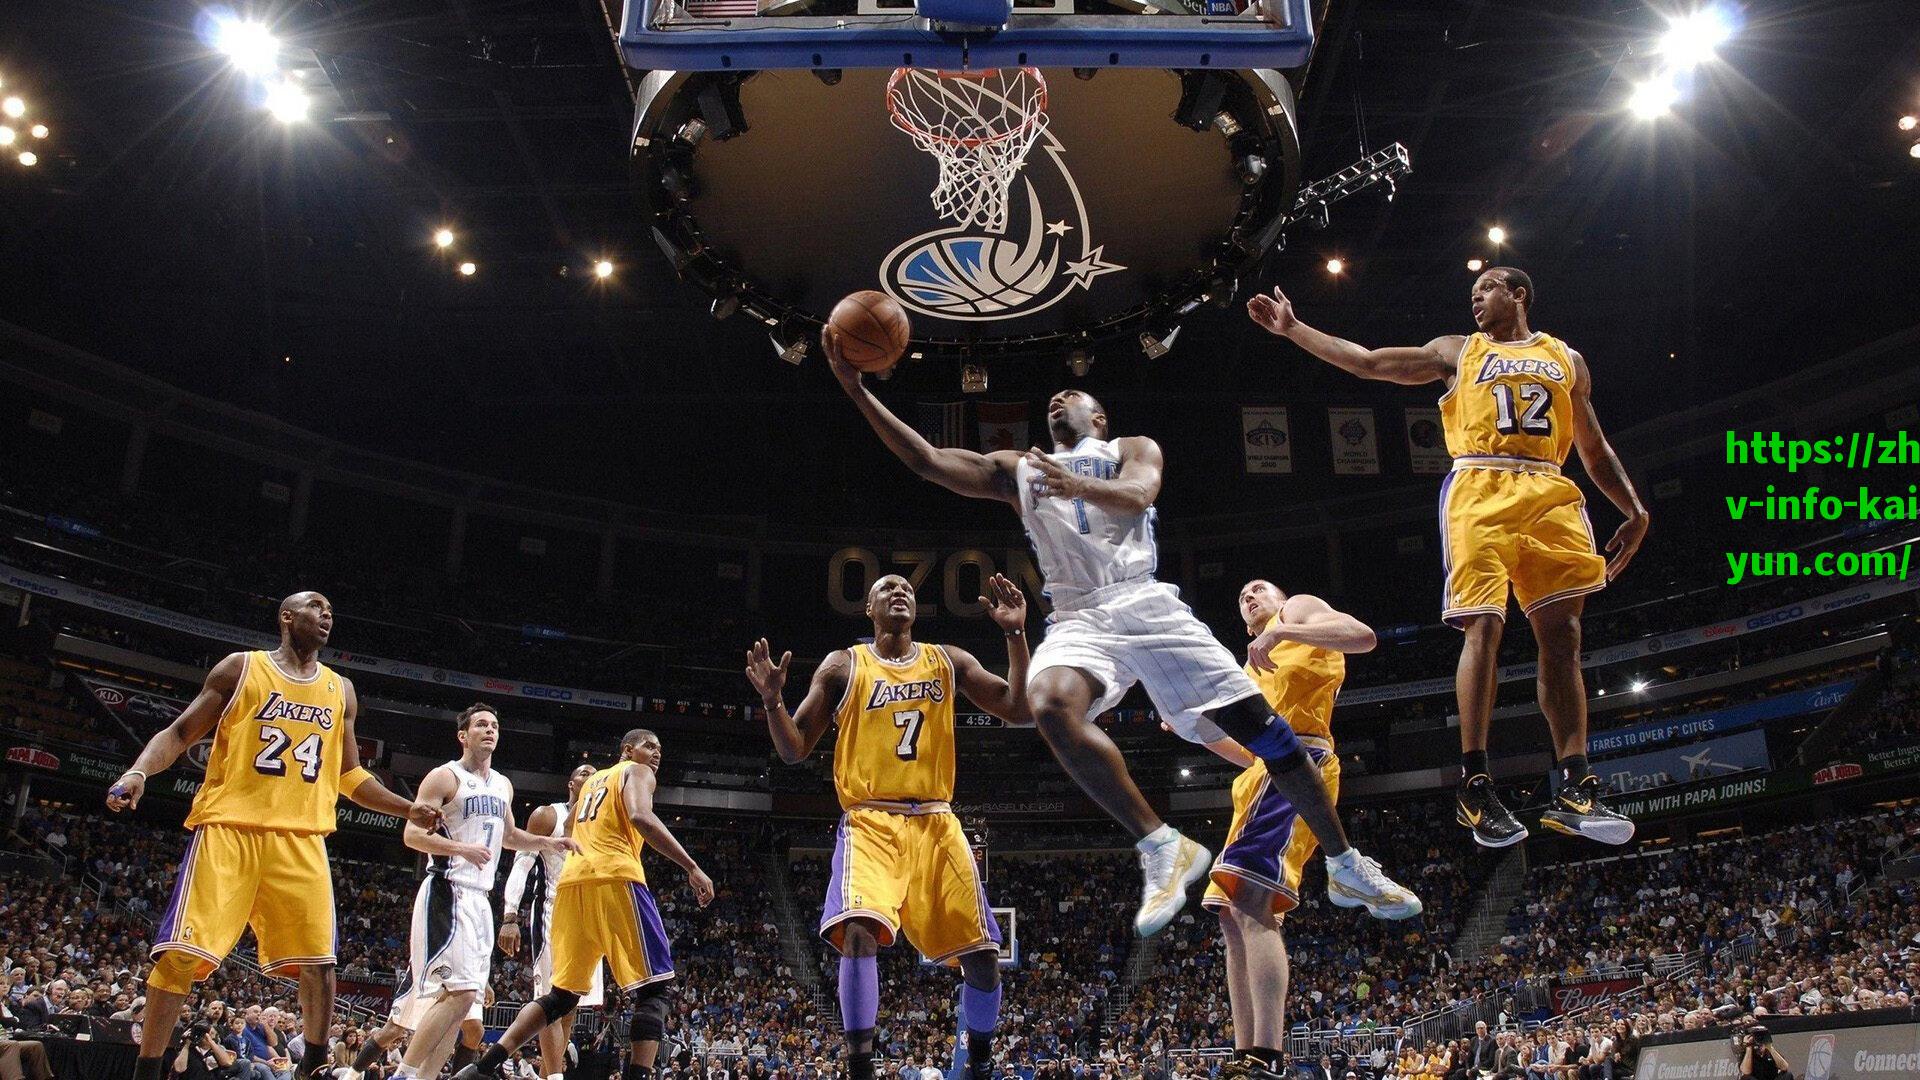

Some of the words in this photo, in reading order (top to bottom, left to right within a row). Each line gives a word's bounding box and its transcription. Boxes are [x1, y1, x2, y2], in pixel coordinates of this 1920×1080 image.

[1211, 2, 1233, 12] NBA
[1475, 353, 1565, 384] LAKERS
[1491, 383, 1553, 436] 12
[1071, 497, 1090, 534] 1
[10, 576, 58, 596] PEPSICO
[1747, 606, 1803, 629] GEICO
[98, 690, 120, 703] KIA
[522, 685, 573, 701] GEICO
[865, 679, 945, 712] LAKERS
[254, 691, 333, 730] LAKERS
[588, 698, 627, 708] PEPSICO
[966, 716, 992, 727] 4:52
[893, 709, 925, 761] 7
[1593, 736, 1622, 752] FARES
[1625, 734, 1637, 745] TO
[1639, 728, 1665, 743] OVER
[1682, 719, 1715, 735] CITIES
[70, 753, 96, 767] Better
[254, 724, 324, 783] 24
[1868, 749, 1895, 762] Better
[1884, 757, 1911, 769] Better
[81, 765, 106, 778] Better
[174, 778, 200, 793] MA
[577, 786, 609, 823] 17
[1040, 801, 1065, 811] BAR
[1619, 801, 1645, 817] WIN
[1649, 796, 1681, 812] WITH
[1685, 789, 1717, 806] PAPA
[1720, 778, 1767, 800] JOHNS!
[355, 811, 400, 829] JOHNS!
[482, 822, 495, 849] 7
[1658, 1062, 1699, 1079] Connect
